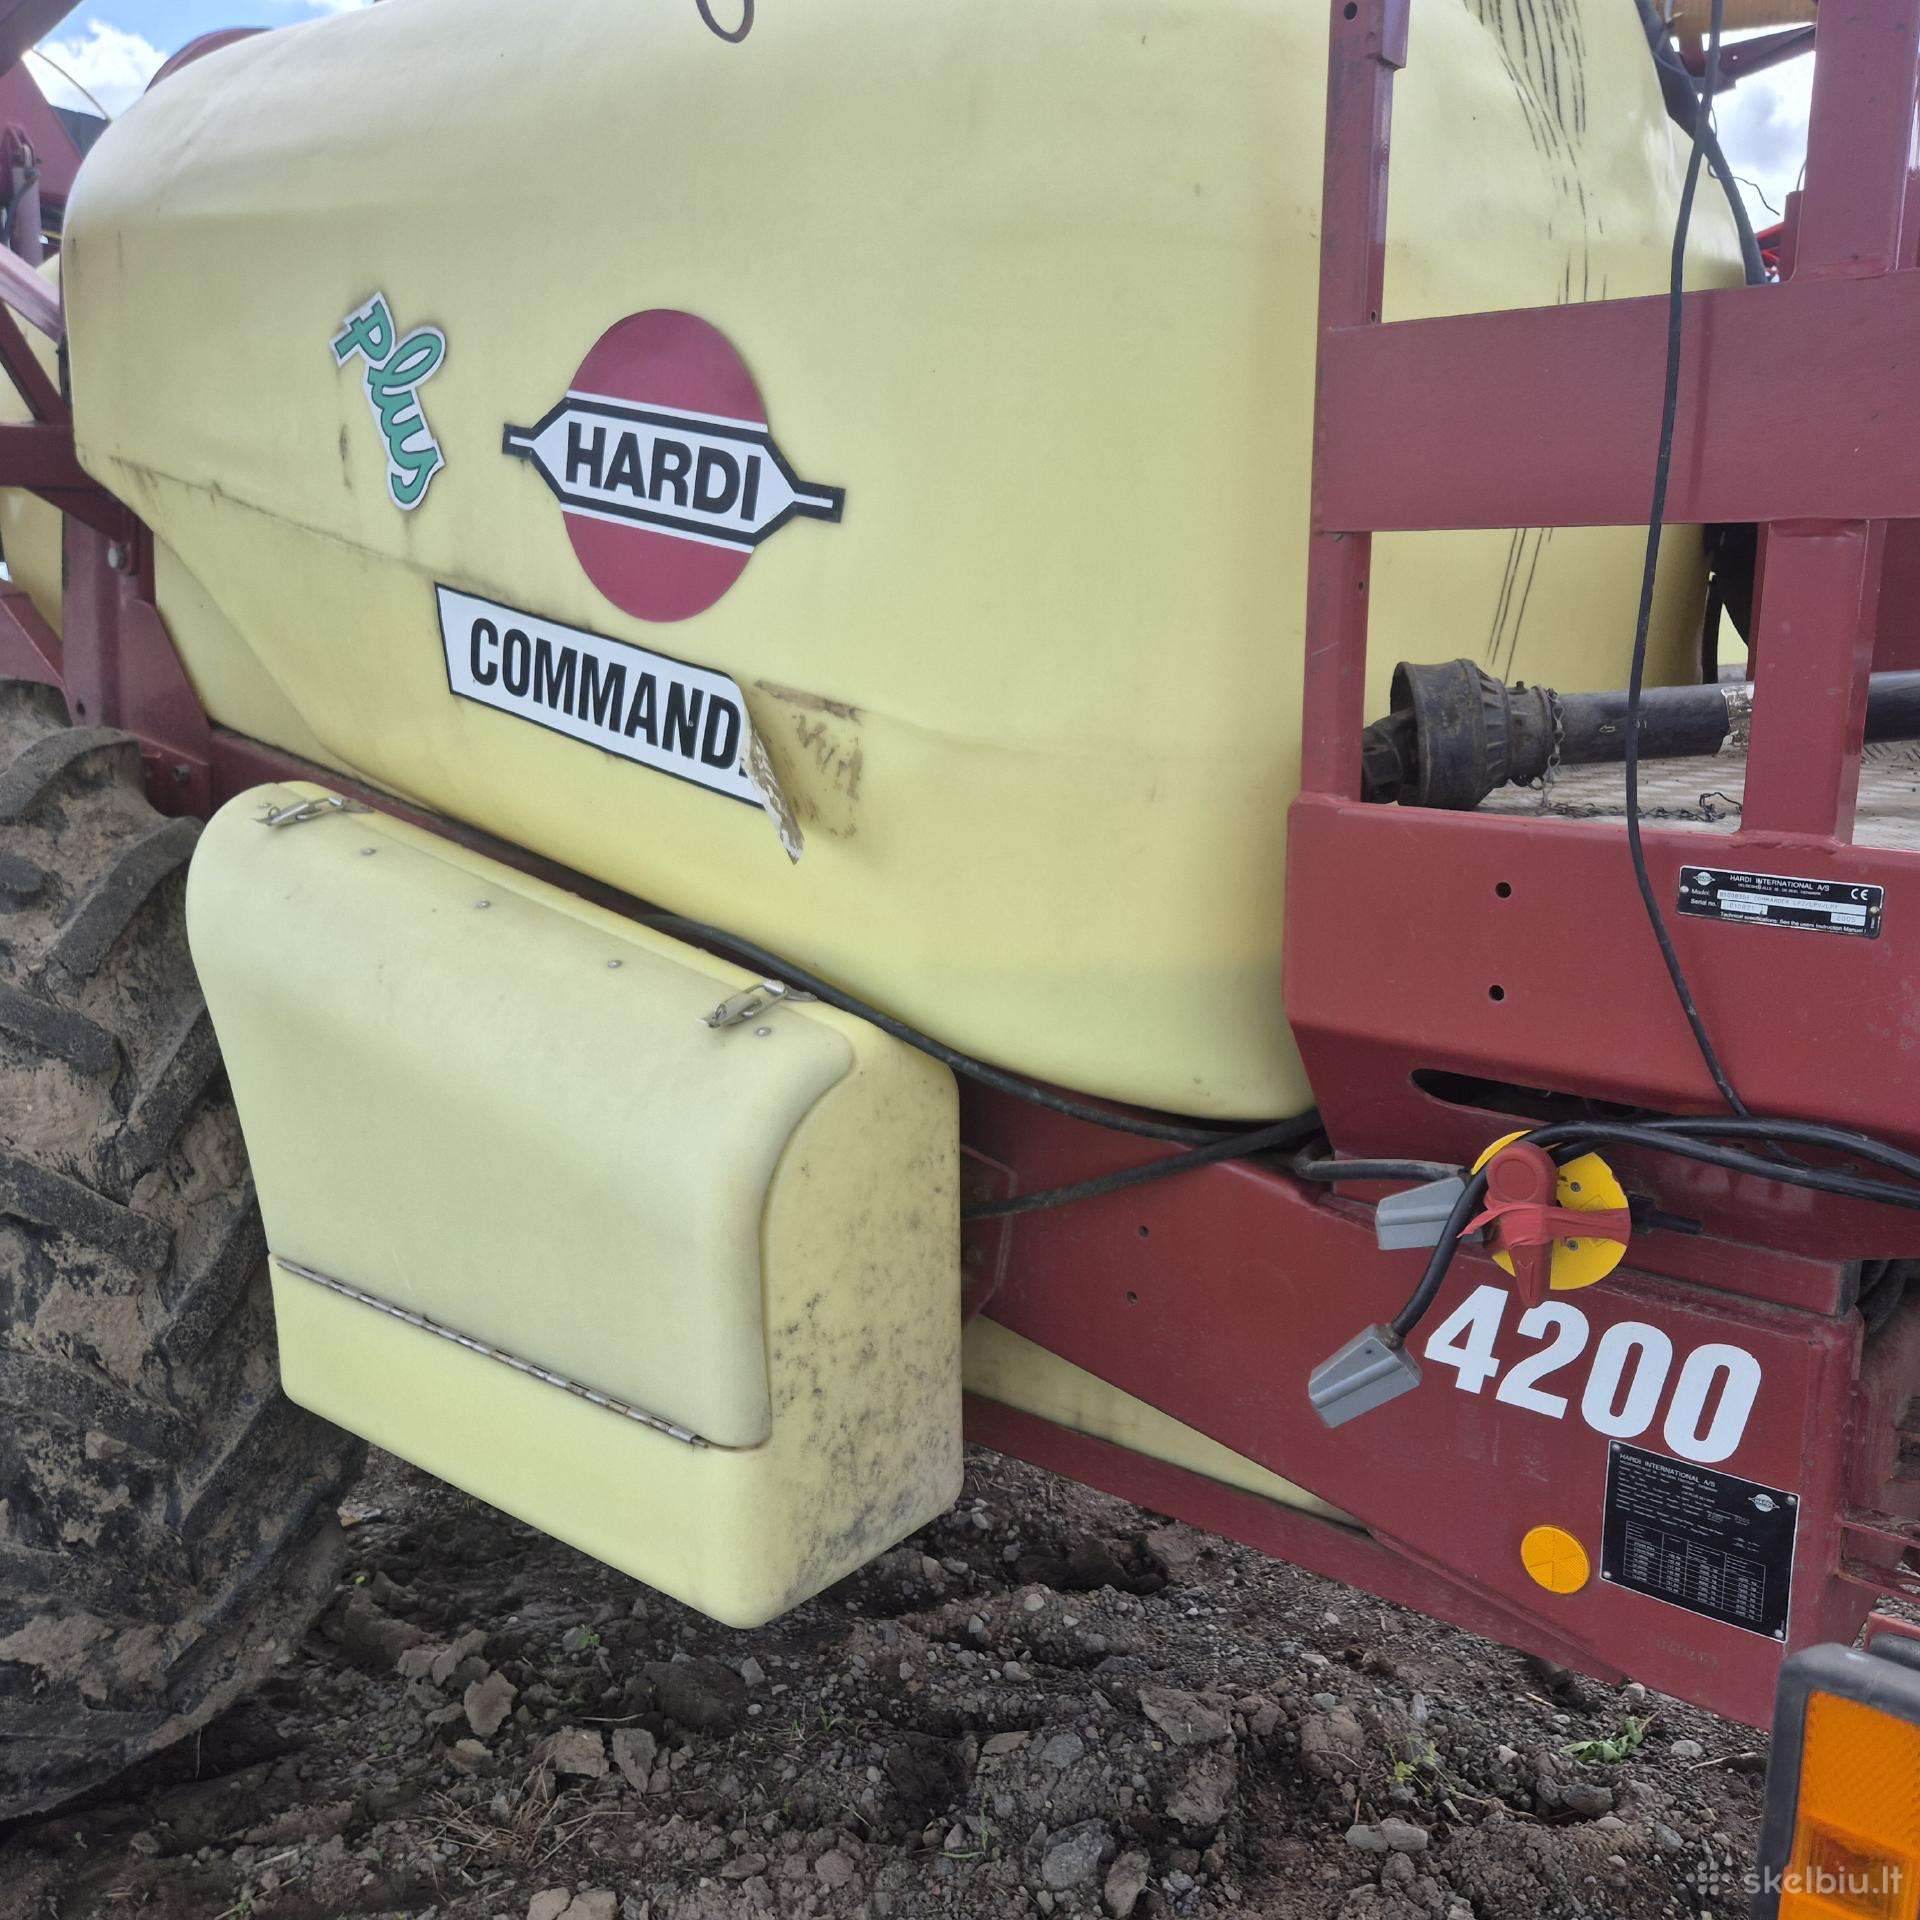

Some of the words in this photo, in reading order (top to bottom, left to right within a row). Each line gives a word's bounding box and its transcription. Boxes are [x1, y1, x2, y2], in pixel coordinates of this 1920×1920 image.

[565, 421, 762, 522] HARDI
[469, 617, 749, 778] COMMAND
[1729, 874, 1752, 883] HARDI
[1755, 877, 1814, 890] INTERNATIONAL
[1423, 1284, 1763, 1463] 4200
[1619, 1453, 1642, 1465] HARDI
[1644, 1460, 1701, 1483] INTERNATIONAL
